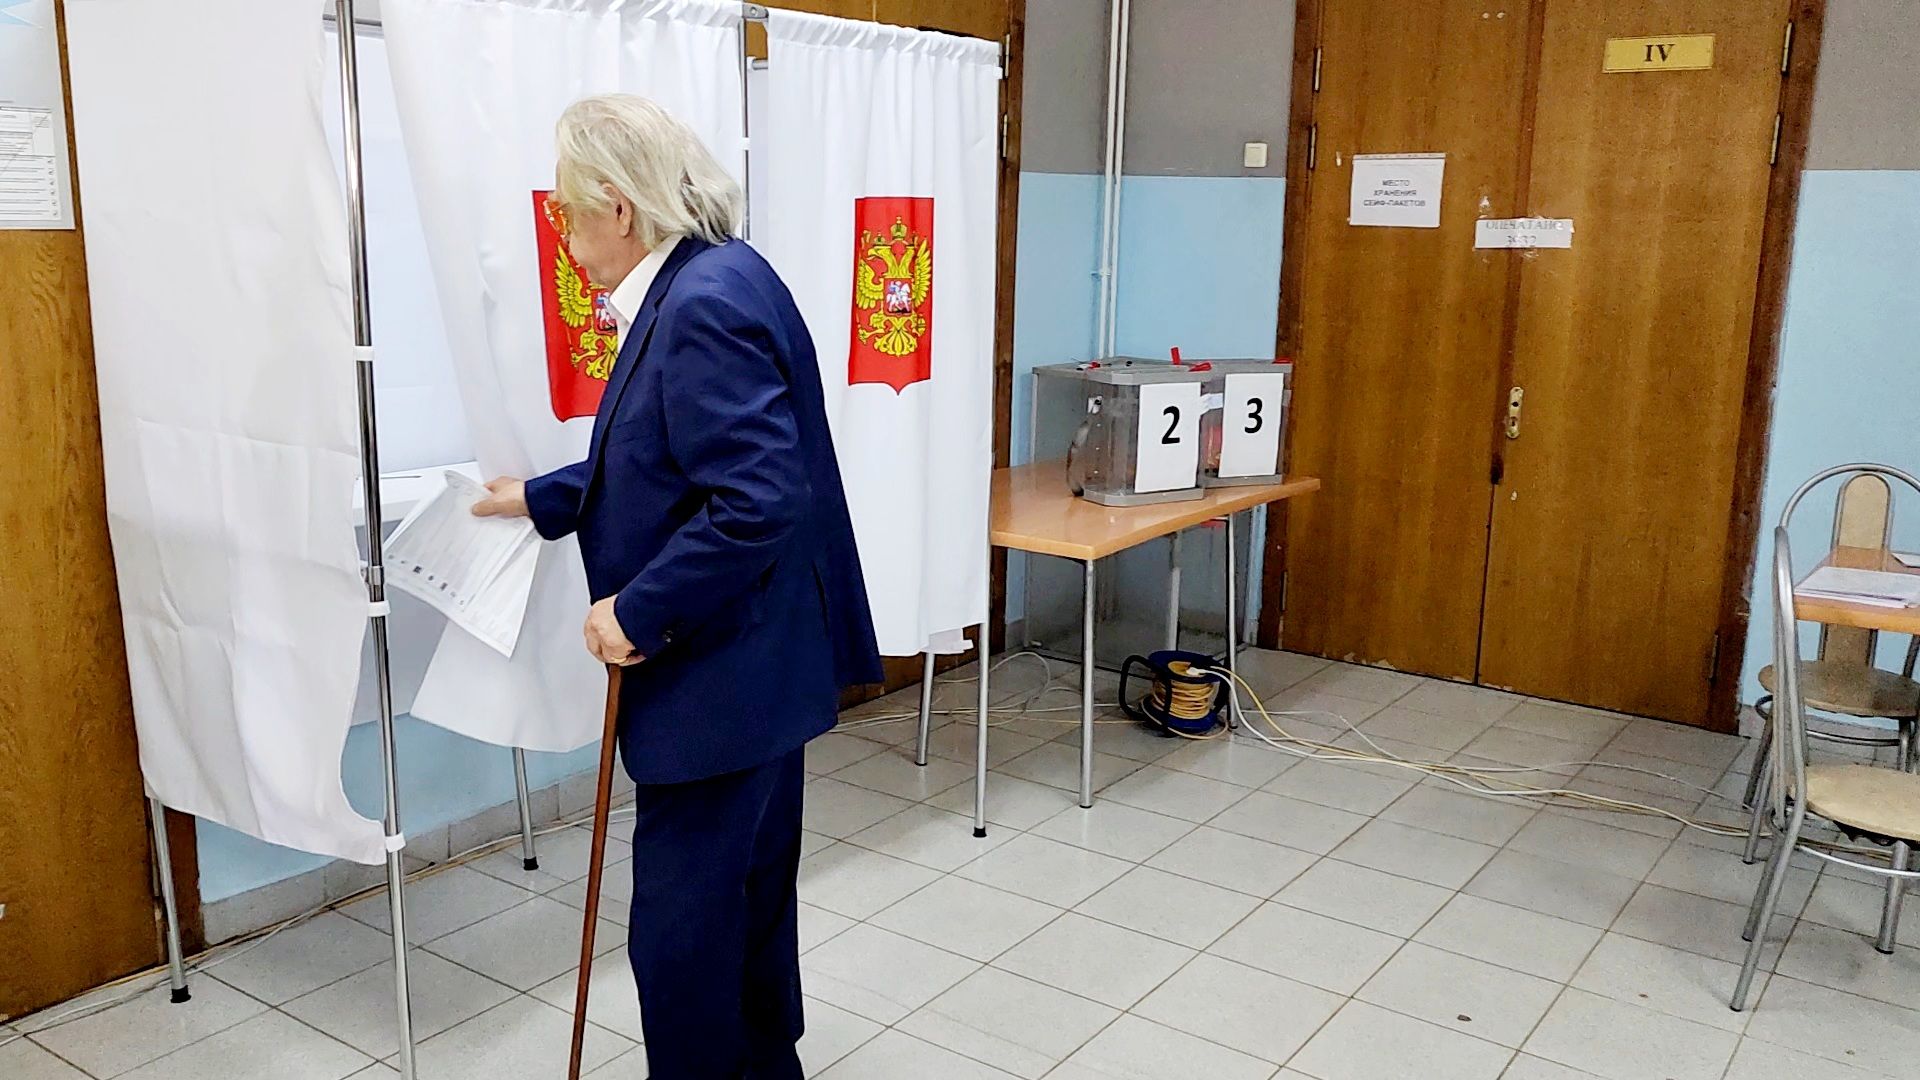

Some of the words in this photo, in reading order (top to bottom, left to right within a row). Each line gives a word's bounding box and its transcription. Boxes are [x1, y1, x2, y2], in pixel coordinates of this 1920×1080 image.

[1645, 44, 1675, 62] IV
[1382, 179, 1410, 187] МЕСТО
[1373, 189, 1417, 197] ХРАНЕНИЯ
[1244, 397, 1263, 434] 3
[1161, 406, 1181, 445] 2
